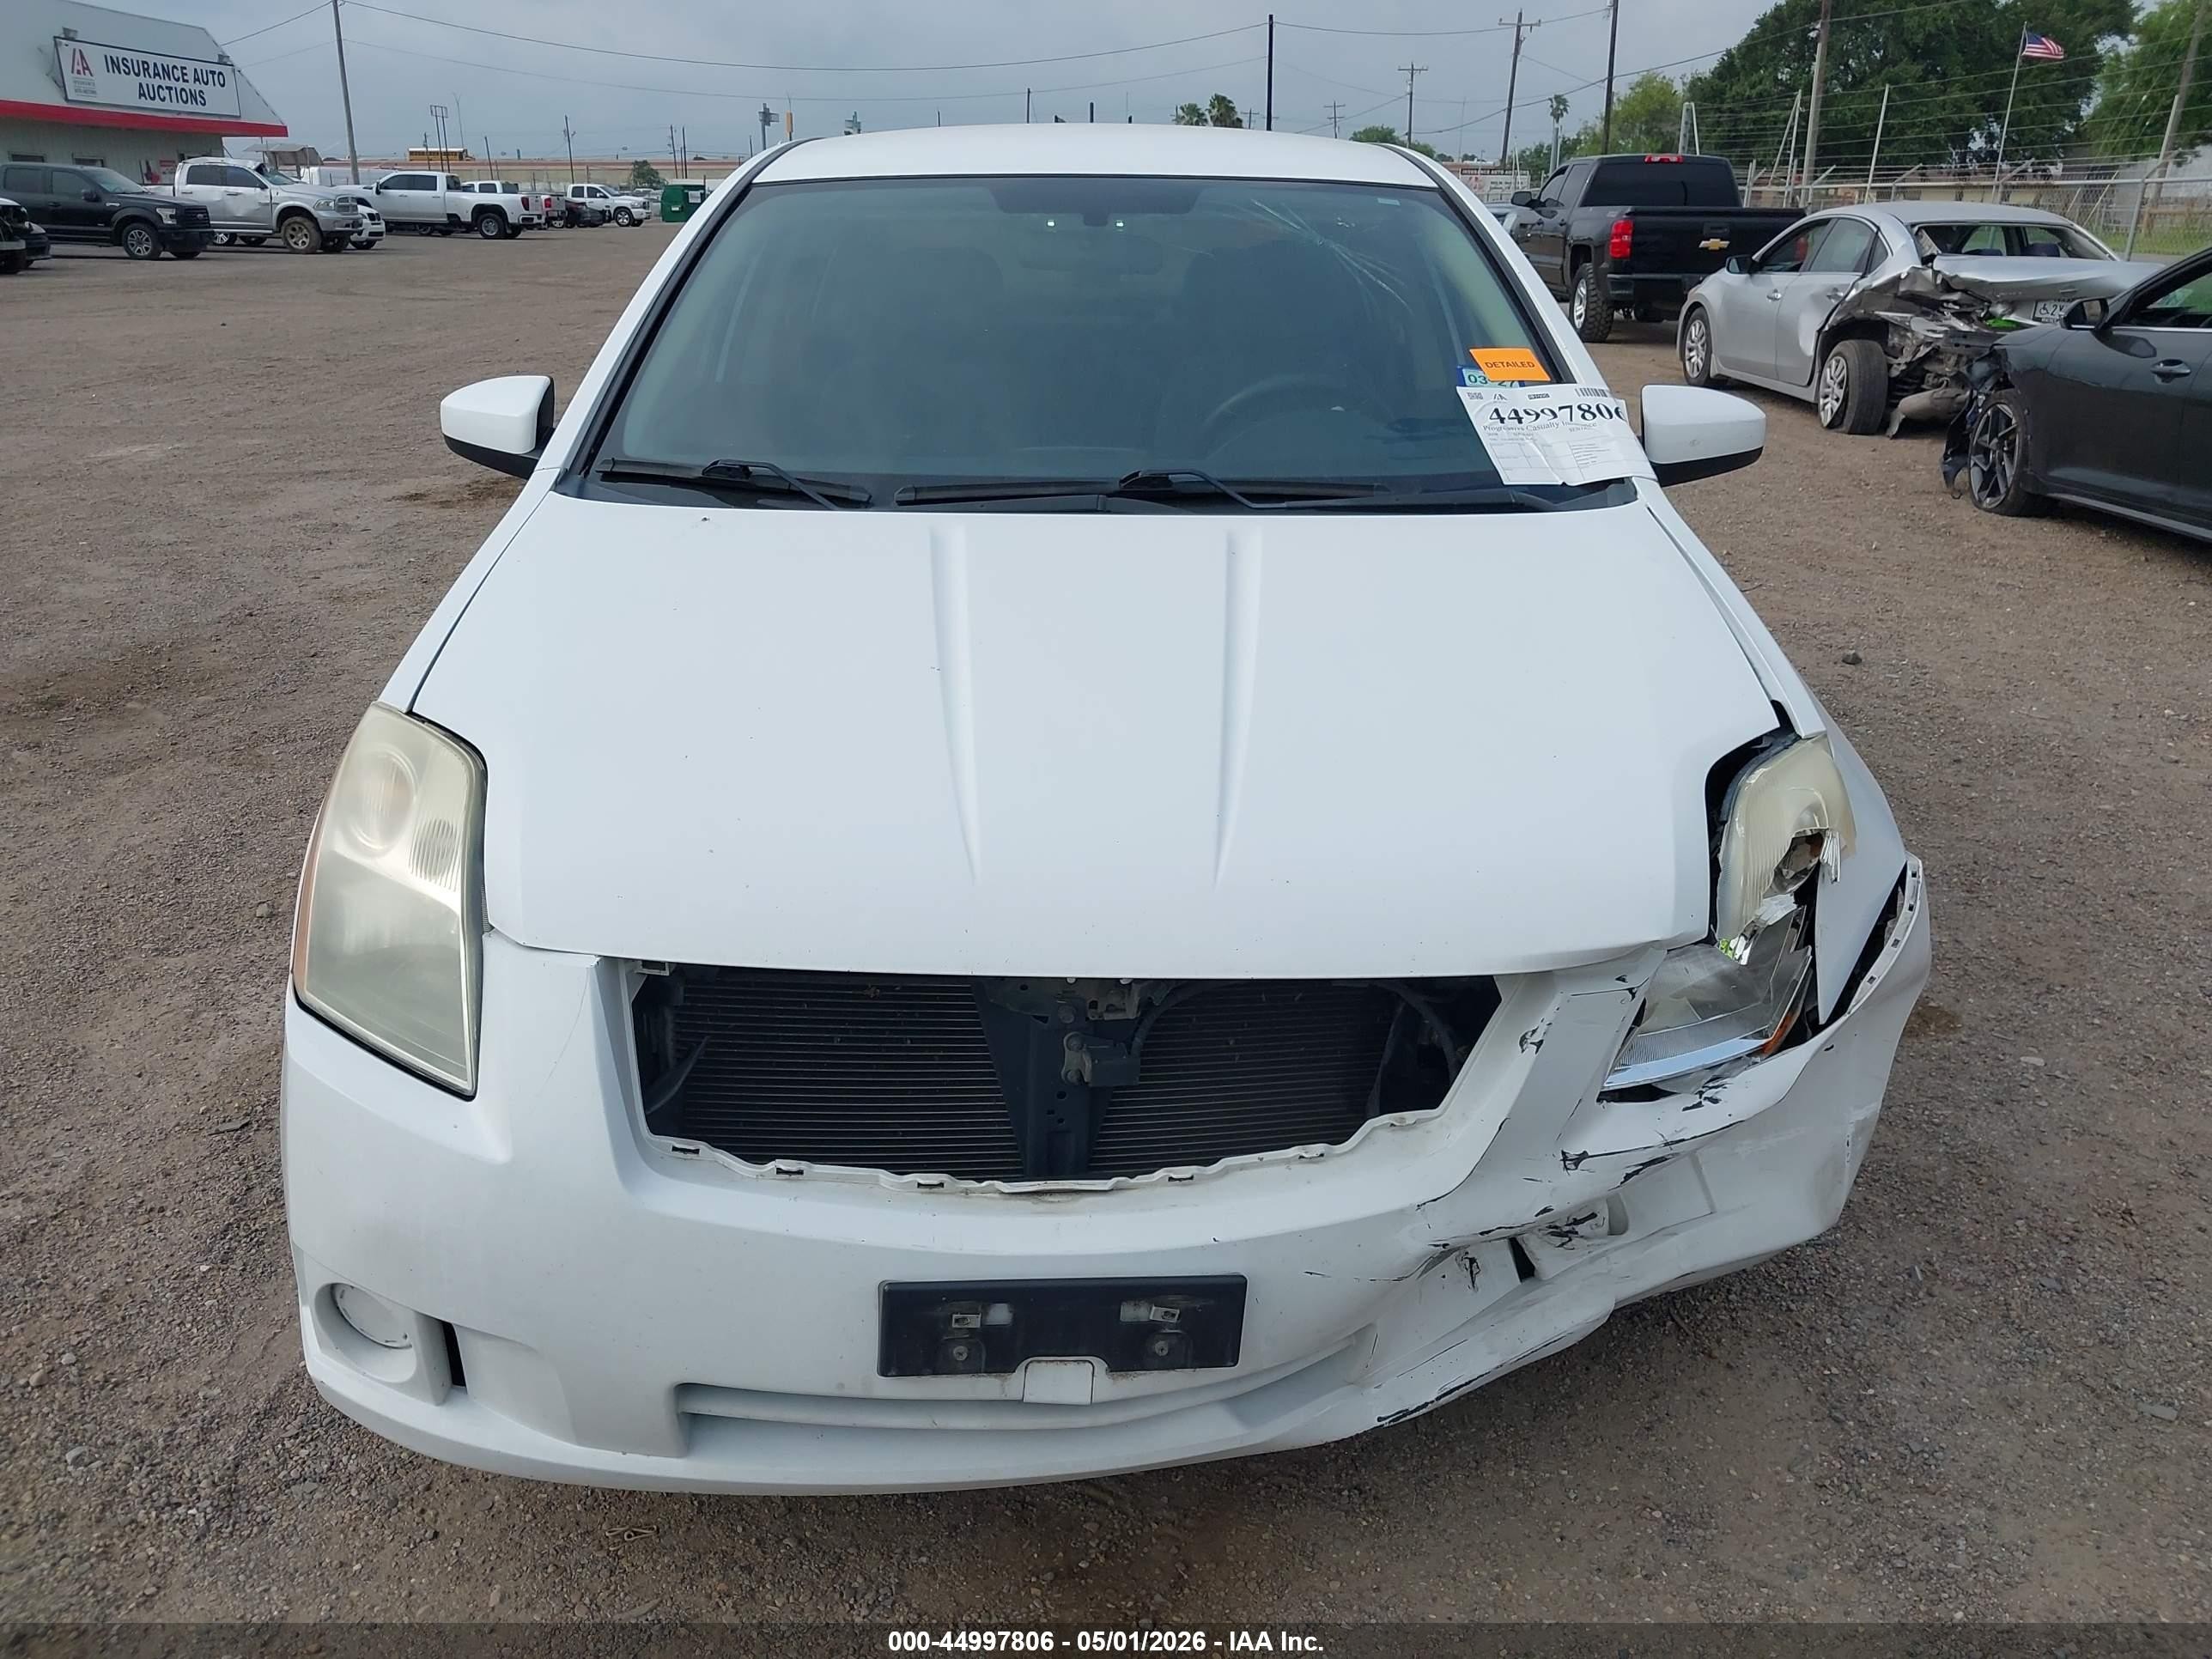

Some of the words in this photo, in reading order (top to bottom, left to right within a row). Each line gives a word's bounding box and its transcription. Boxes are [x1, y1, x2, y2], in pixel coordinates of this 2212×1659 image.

[104, 54, 189, 83] INSURANCE
[192, 68, 226, 88] AUTO
[137, 82, 207, 106] AUCTIONS
[1468, 374, 1488, 385] 03
[1526, 421, 1560, 431] Casualty
